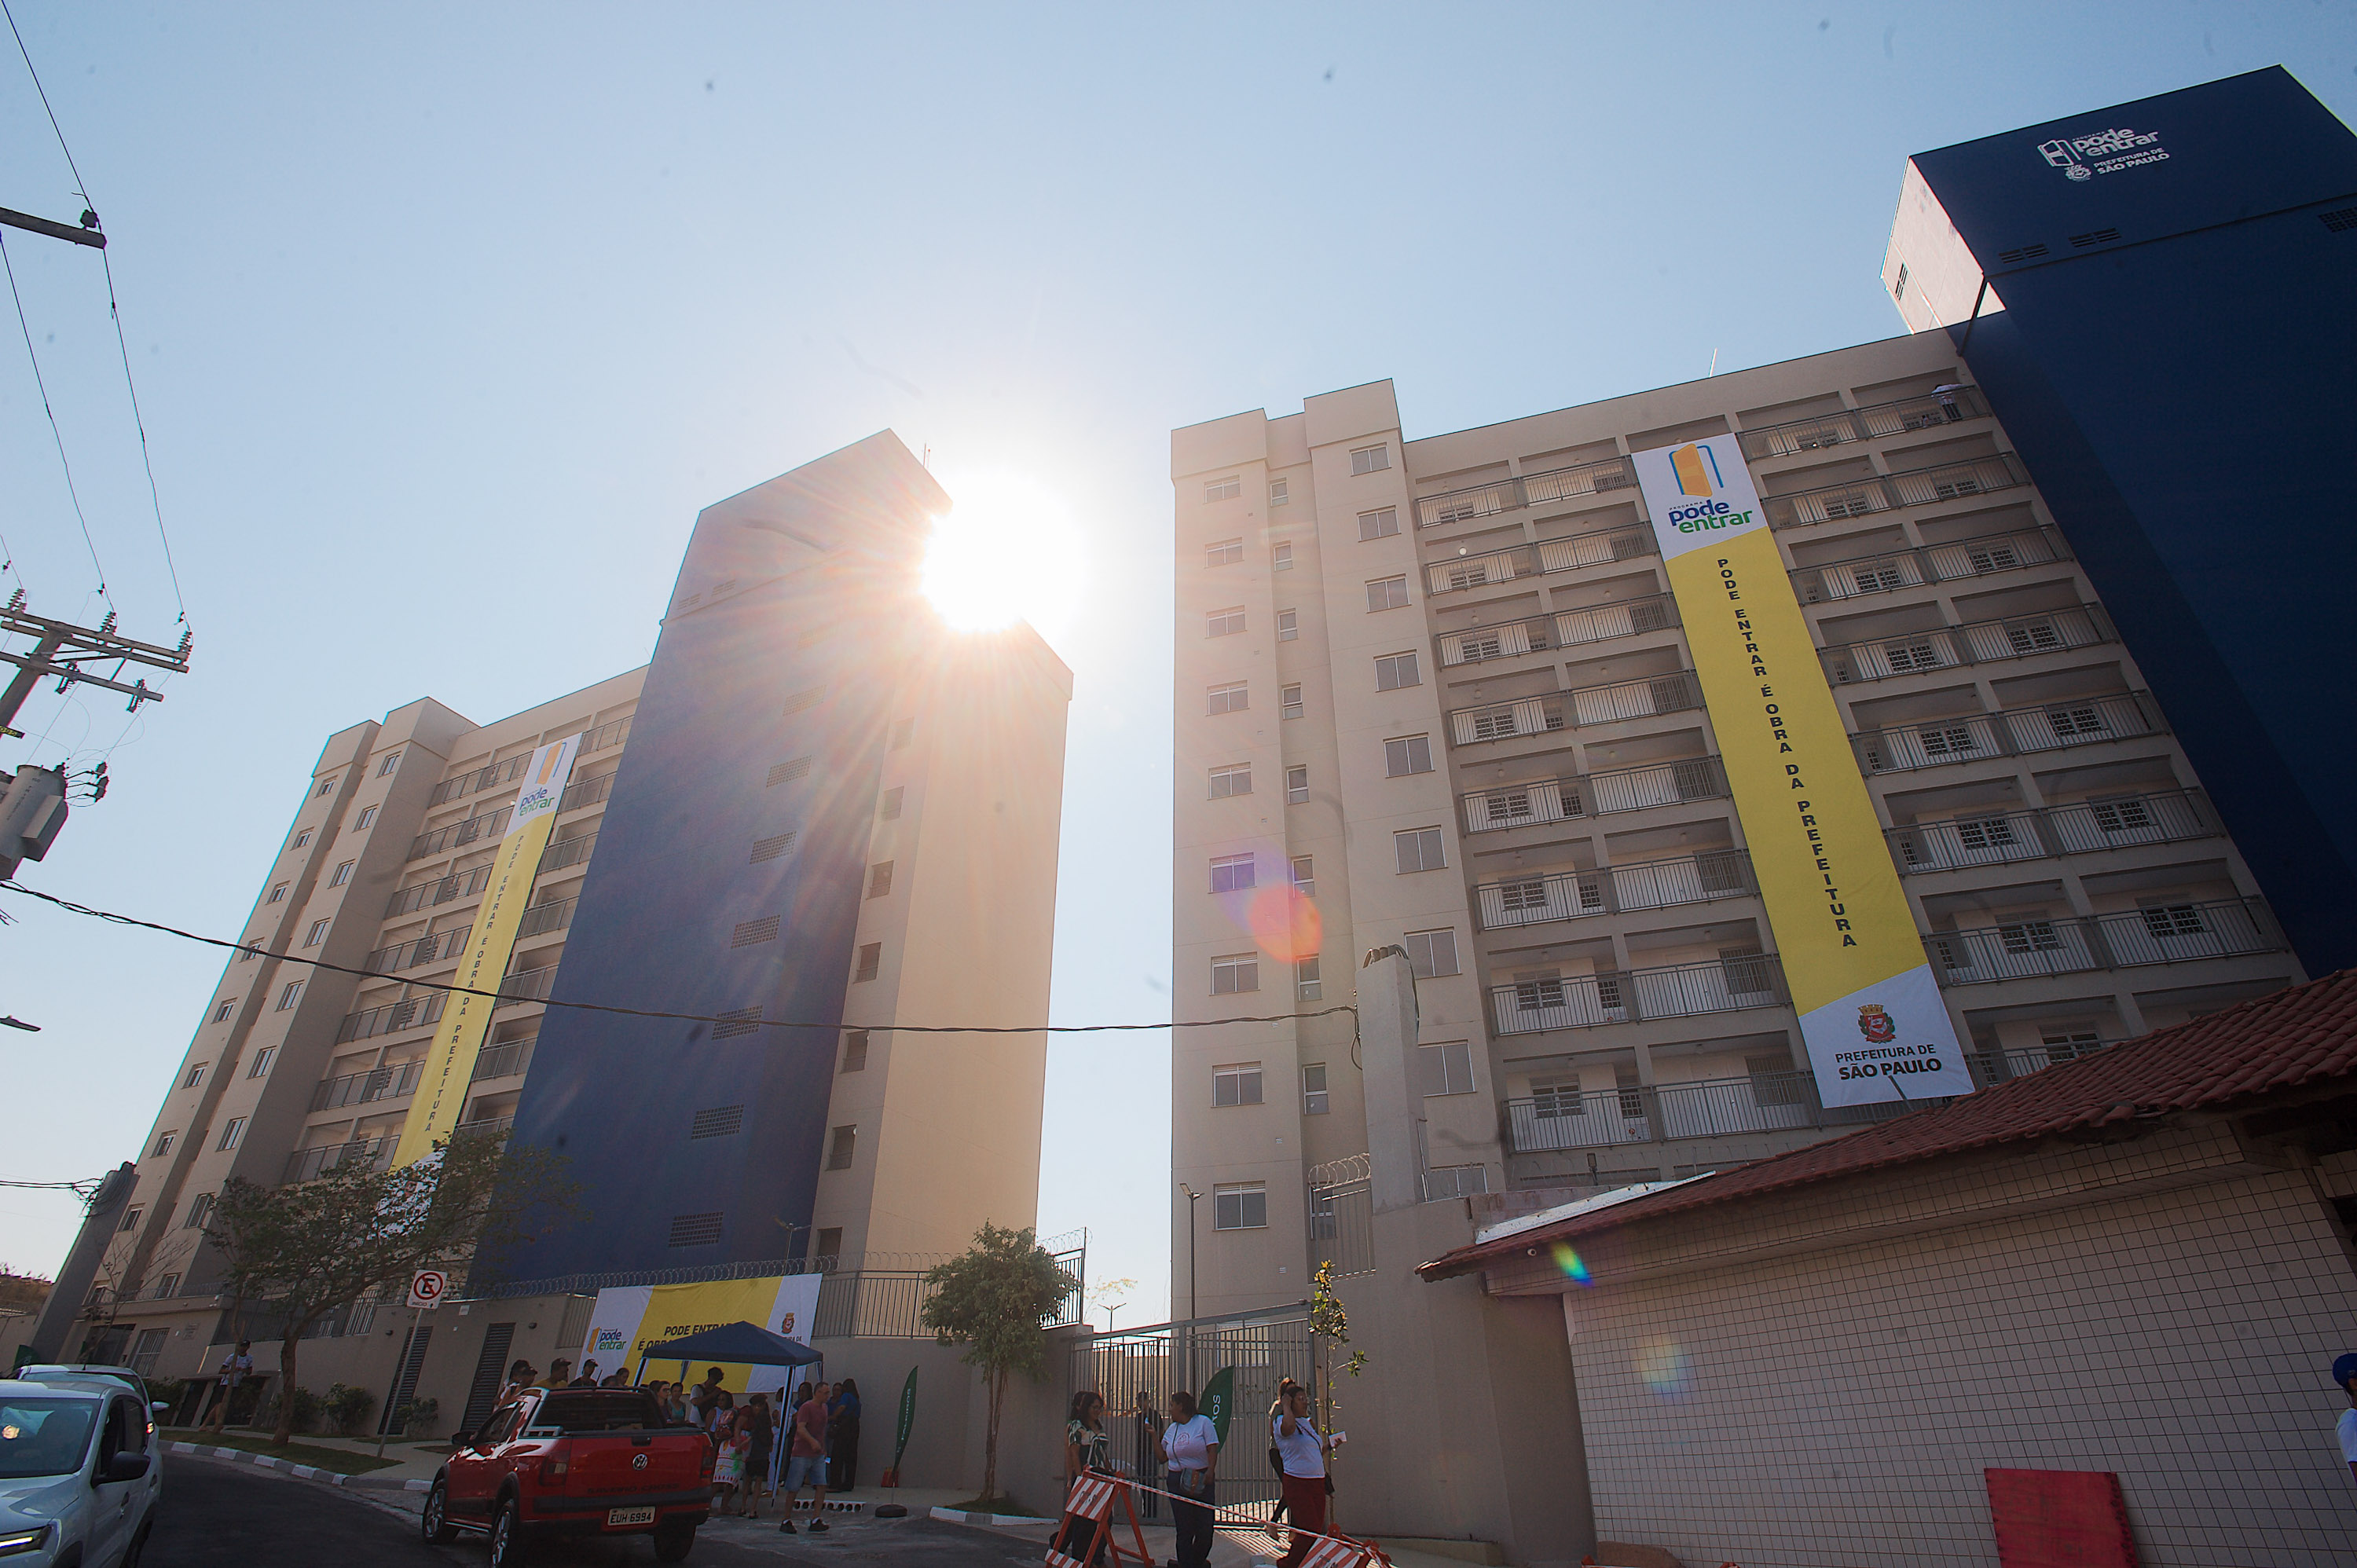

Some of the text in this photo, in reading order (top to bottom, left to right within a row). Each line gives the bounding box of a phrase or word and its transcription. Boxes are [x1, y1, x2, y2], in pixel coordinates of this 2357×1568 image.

[2073, 128, 2135, 152] pode
[2086, 131, 2159, 156] entrar
[2093, 151, 2150, 168] PREFEITURA
[2096, 152, 2170, 174] SÃO PAULO
[1668, 499, 1730, 527] pode
[1669, 501, 1703, 511] PROGRAMA
[1678, 510, 1753, 533] entrar
[1717, 559, 1857, 947] PODE ENTRAR É OBRA DA PREFEITURA
[519, 787, 548, 810] pode
[519, 797, 555, 816] entrar
[508, 835, 524, 869] PODE
[486, 875, 509, 930] ENTRAR
[467, 950, 484, 989] OBRA
[460, 997, 470, 1016] DA
[1835, 1043, 1936, 1064] PREFEITURA DE
[424, 1024, 462, 1132] PREFEITURA
[1838, 1057, 1942, 1080] SÃO PAULO
[599, 1328, 622, 1343] pode
[664, 1324, 691, 1336] PODE
[599, 1340, 627, 1350] entrar
[638, 1337, 646, 1350] É
[610, 1512, 651, 1523] EUH 6994
